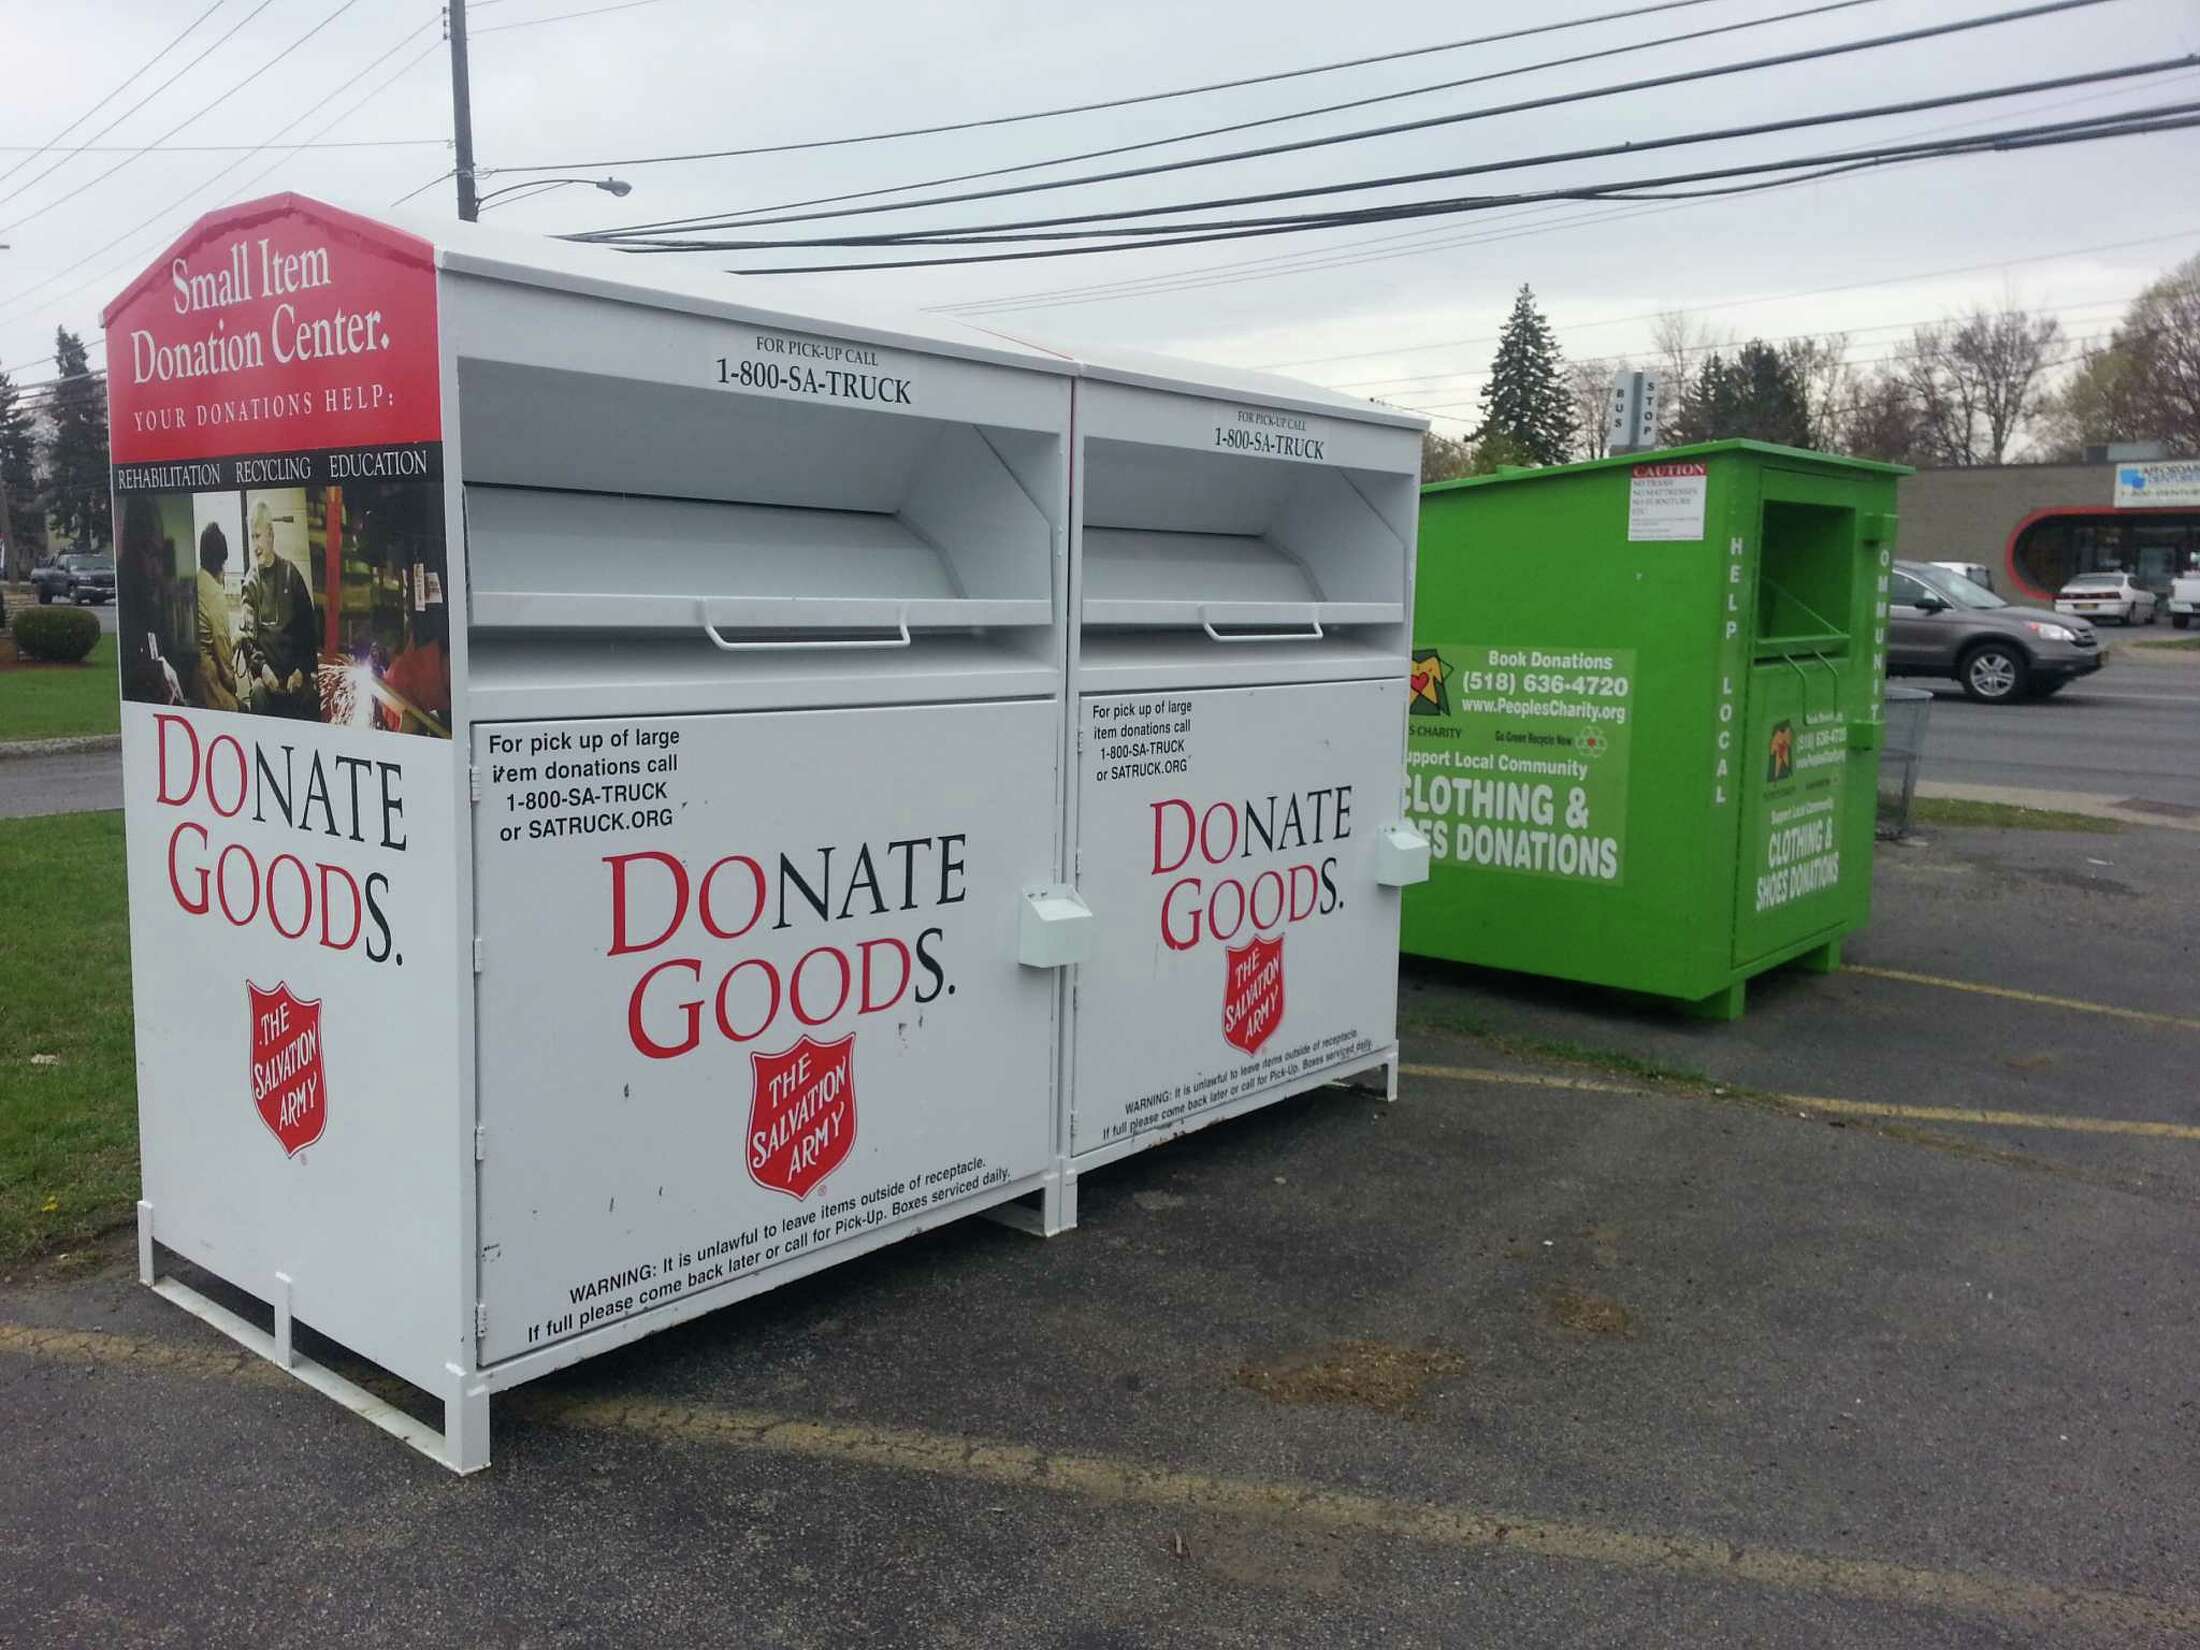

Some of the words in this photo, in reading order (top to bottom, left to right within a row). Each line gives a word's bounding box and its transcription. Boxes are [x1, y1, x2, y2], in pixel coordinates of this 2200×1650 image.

[172, 239, 252, 315] Small
[258, 238, 331, 298] Item
[131, 320, 263, 384] Donation
[271, 303, 390, 364] Center.
[756, 336, 784, 353] FOR
[788, 340, 842, 361] PICK-UP
[845, 349, 878, 366] CALL
[716, 357, 912, 404] 1-800-SA-TRUCK
[134, 407, 185, 431] YOUR
[197, 391, 312, 426] DONATIONS
[326, 384, 394, 412] HELP:
[1238, 411, 1254, 423] FOR
[1614, 388, 1624, 428] BUS
[1644, 382, 1655, 435] STOP
[1215, 427, 1324, 460] 1-800-SA-TRUCK
[118, 463, 220, 490] REHABILITATION
[236, 456, 311, 483] RECYCLING
[330, 449, 428, 478] EDUCATION
[1633, 464, 1705, 477] CAUTION
[1726, 537, 1742, 640] HELP
[1489, 650, 1526, 667] Book
[1531, 652, 1613, 670] Donations
[1870, 549, 1890, 720] OMMUNIT
[1463, 671, 1515, 695] (518)
[1093, 705, 1110, 718] For
[1114, 703, 1135, 720] pick
[1139, 703, 1151, 717] up
[1155, 700, 1165, 714] of
[1168, 700, 1192, 715] large
[1094, 726, 1116, 740] item
[1121, 722, 1170, 738] donations
[1174, 719, 1190, 733] call
[1418, 726, 1462, 739] CHARITY
[1462, 698, 1626, 724] www.PeoplesCharity.org
[489, 734, 522, 753] For
[531, 732, 572, 756] pick
[580, 734, 603, 752] up
[610, 729, 629, 747] of
[636, 729, 680, 749] large
[1100, 740, 1184, 760] 1-800-SA-TRUCK
[1716, 676, 1733, 804] LOCAL
[153, 713, 407, 851] DONATE
[493, 764, 537, 783] item
[545, 758, 641, 779] donations
[647, 754, 678, 772] call
[1096, 771, 1107, 781] or
[1111, 759, 1187, 780] SATRUCK.ORG
[1455, 752, 1493, 769] Local
[1498, 755, 1588, 780] Community
[507, 782, 667, 811] 1-800-SA-TRUCK
[1565, 786, 1589, 829] &
[500, 827, 521, 841] or
[529, 808, 673, 838] SATRUCK.ORG
[1150, 786, 1353, 875] DONATE
[1768, 819, 1823, 869] CLOTHING
[1456, 823, 1618, 880] DONATIONS
[168, 822, 403, 966] GOODS.
[602, 834, 966, 956] DONATE
[1161, 857, 1344, 950] GOODS.
[1756, 867, 1788, 912] SHOES
[1789, 851, 1840, 899] DONATIONS
[628, 928, 956, 1058] GOODS.
[1226, 950, 1279, 1033] SALVATION
[1235, 947, 1260, 989] THE
[260, 1002, 290, 1046] THE
[1245, 984, 1279, 1044] ARMY
[254, 1021, 317, 1100] SALVATION
[769, 1053, 812, 1109] THE
[1125, 1091, 1172, 1115] WARNING:
[1175, 1088, 1181, 1098] It
[1184, 1084, 1191, 1095] is
[1193, 1071, 1228, 1092] unlawful
[1230, 1070, 1238, 1080] to
[1241, 1063, 1260, 1076] leave
[1285, 1045, 1311, 1060] outside
[1312, 1040, 1320, 1051] of
[279, 1071, 317, 1131] ARMY
[753, 1056, 846, 1169] SALVATION
[1103, 1128, 1109, 1140] If
[1113, 1121, 1127, 1135] full
[1130, 1113, 1158, 1133] please
[1162, 1104, 1185, 1119] come
[1188, 1095, 1207, 1111] back
[1210, 1089, 1228, 1102] later
[1230, 1086, 1239, 1095] or
[1241, 1078, 1255, 1092] call
[1257, 1075, 1267, 1086] for
[1302, 1057, 1324, 1070] Boxes
[1326, 1046, 1354, 1060] serviced
[787, 1101, 845, 1183] ARMY
[528, 1324, 540, 1343] If
[547, 1313, 572, 1336] full
[580, 1296, 633, 1329] please
[639, 1279, 682, 1304] come
[688, 1264, 723, 1287] back
[728, 1250, 760, 1272] later
[765, 1246, 780, 1260] or
[785, 1233, 808, 1253] call
[813, 1227, 831, 1242] for
[835, 1208, 887, 1235] Pick-Up.
[892, 1196, 928, 1216] Boxes
[931, 1177, 979, 1203] serviced
[982, 1167, 1011, 1186] daily.
[569, 1264, 656, 1304] WARNING:
[663, 1258, 673, 1273] It
[679, 1252, 691, 1268] is
[697, 1228, 758, 1262] unlawful
[764, 1224, 777, 1238] to
[782, 1211, 816, 1233] leave
[821, 1196, 856, 1218] items
[860, 1182, 905, 1206] outside
[909, 1175, 921, 1192] of
[925, 1156, 986, 1187] receptacle.
